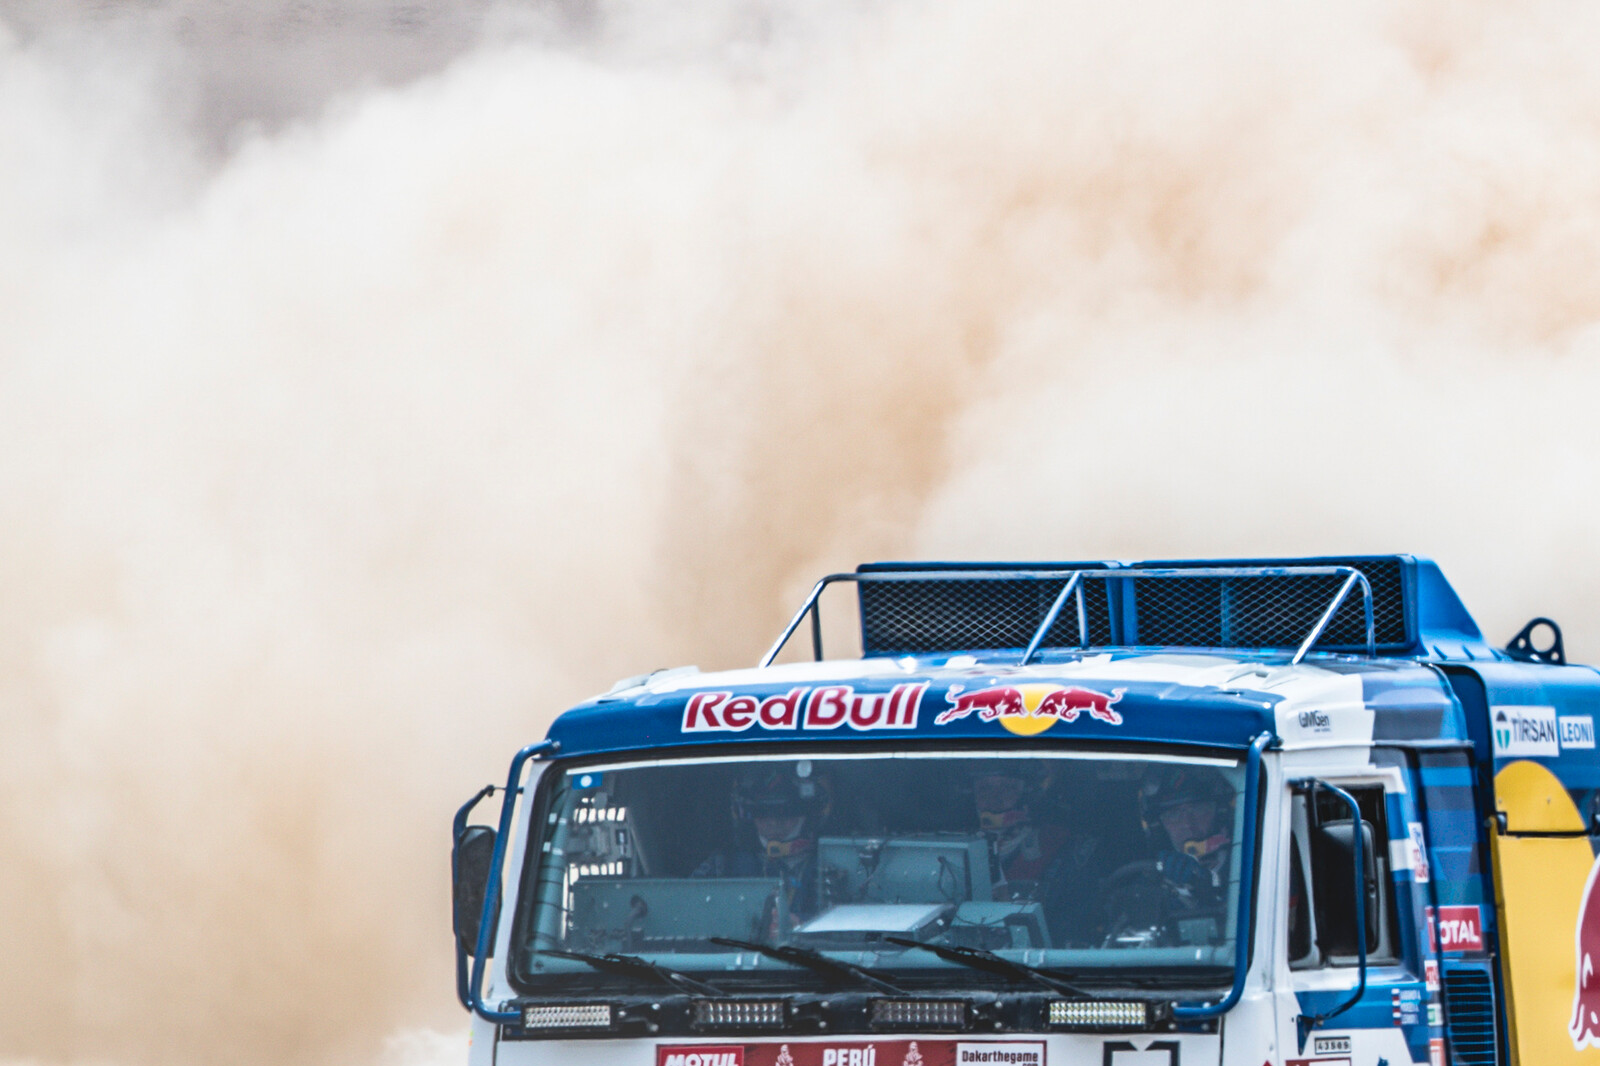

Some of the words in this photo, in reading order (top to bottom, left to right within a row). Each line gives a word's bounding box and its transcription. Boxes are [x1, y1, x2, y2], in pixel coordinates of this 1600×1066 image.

[684, 687, 805, 731] Red
[804, 683, 928, 730] Bull
[1560, 723, 1594, 743] LEONI
[962, 1050, 1039, 1064] Dakarthegame
